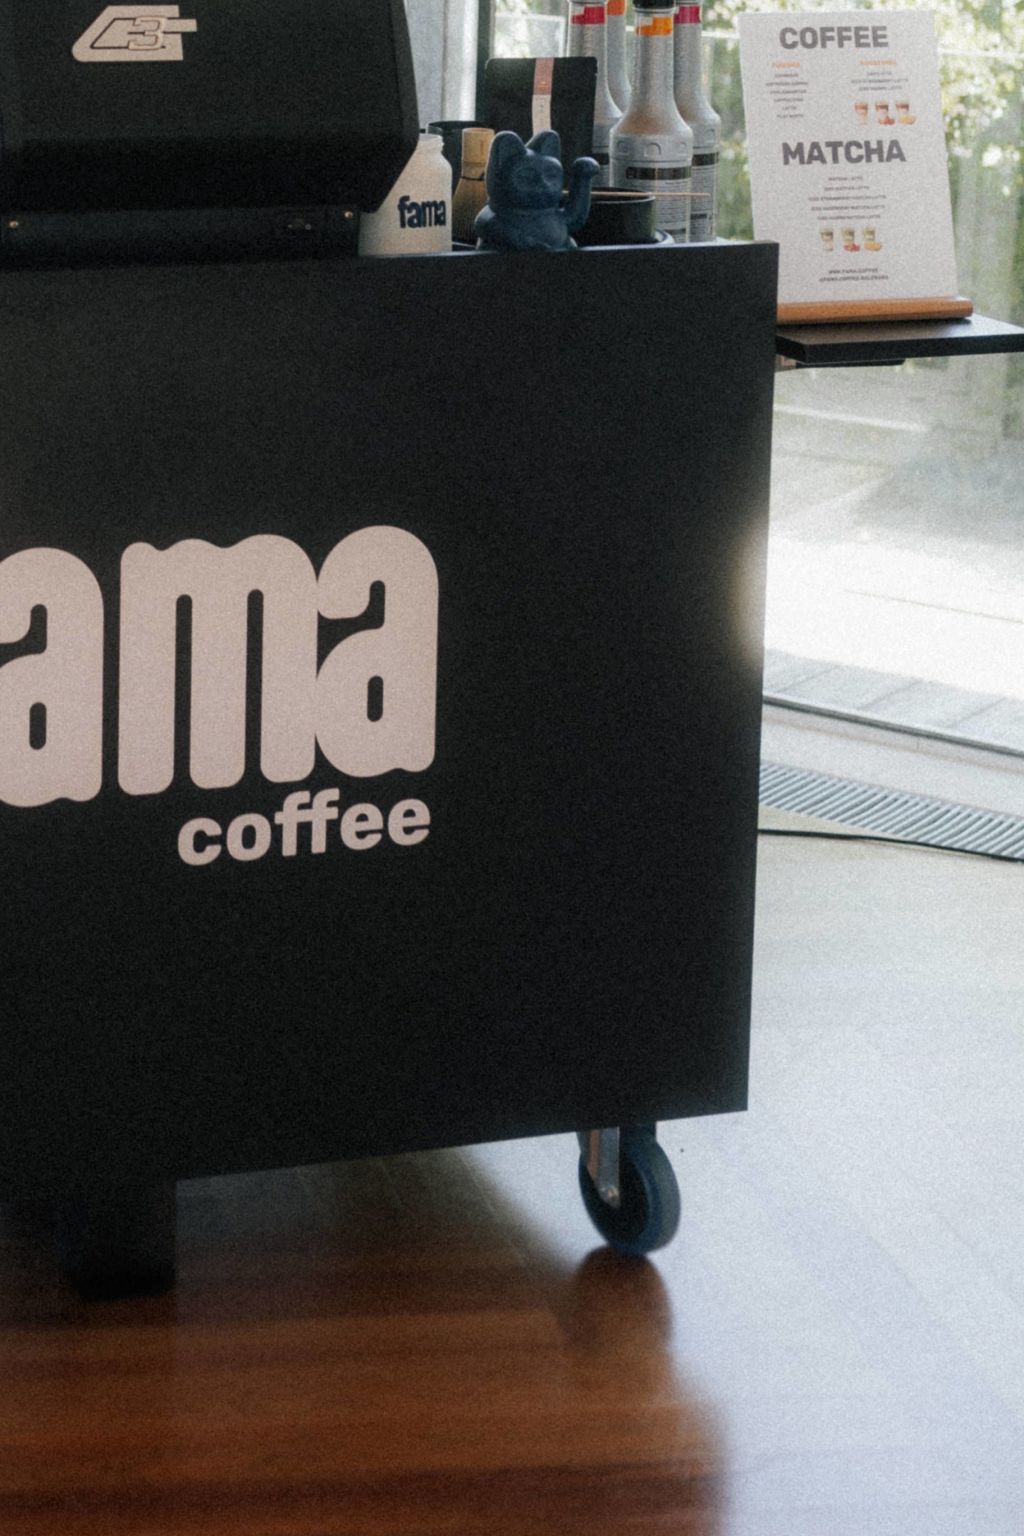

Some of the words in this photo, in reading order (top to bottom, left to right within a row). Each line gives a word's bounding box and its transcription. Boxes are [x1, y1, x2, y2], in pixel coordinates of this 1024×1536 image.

[779, 25, 889, 50] COFFEE
[782, 139, 906, 166] MATCHA
[397, 195, 447, 229] fama
[177, 787, 432, 866] coffee
